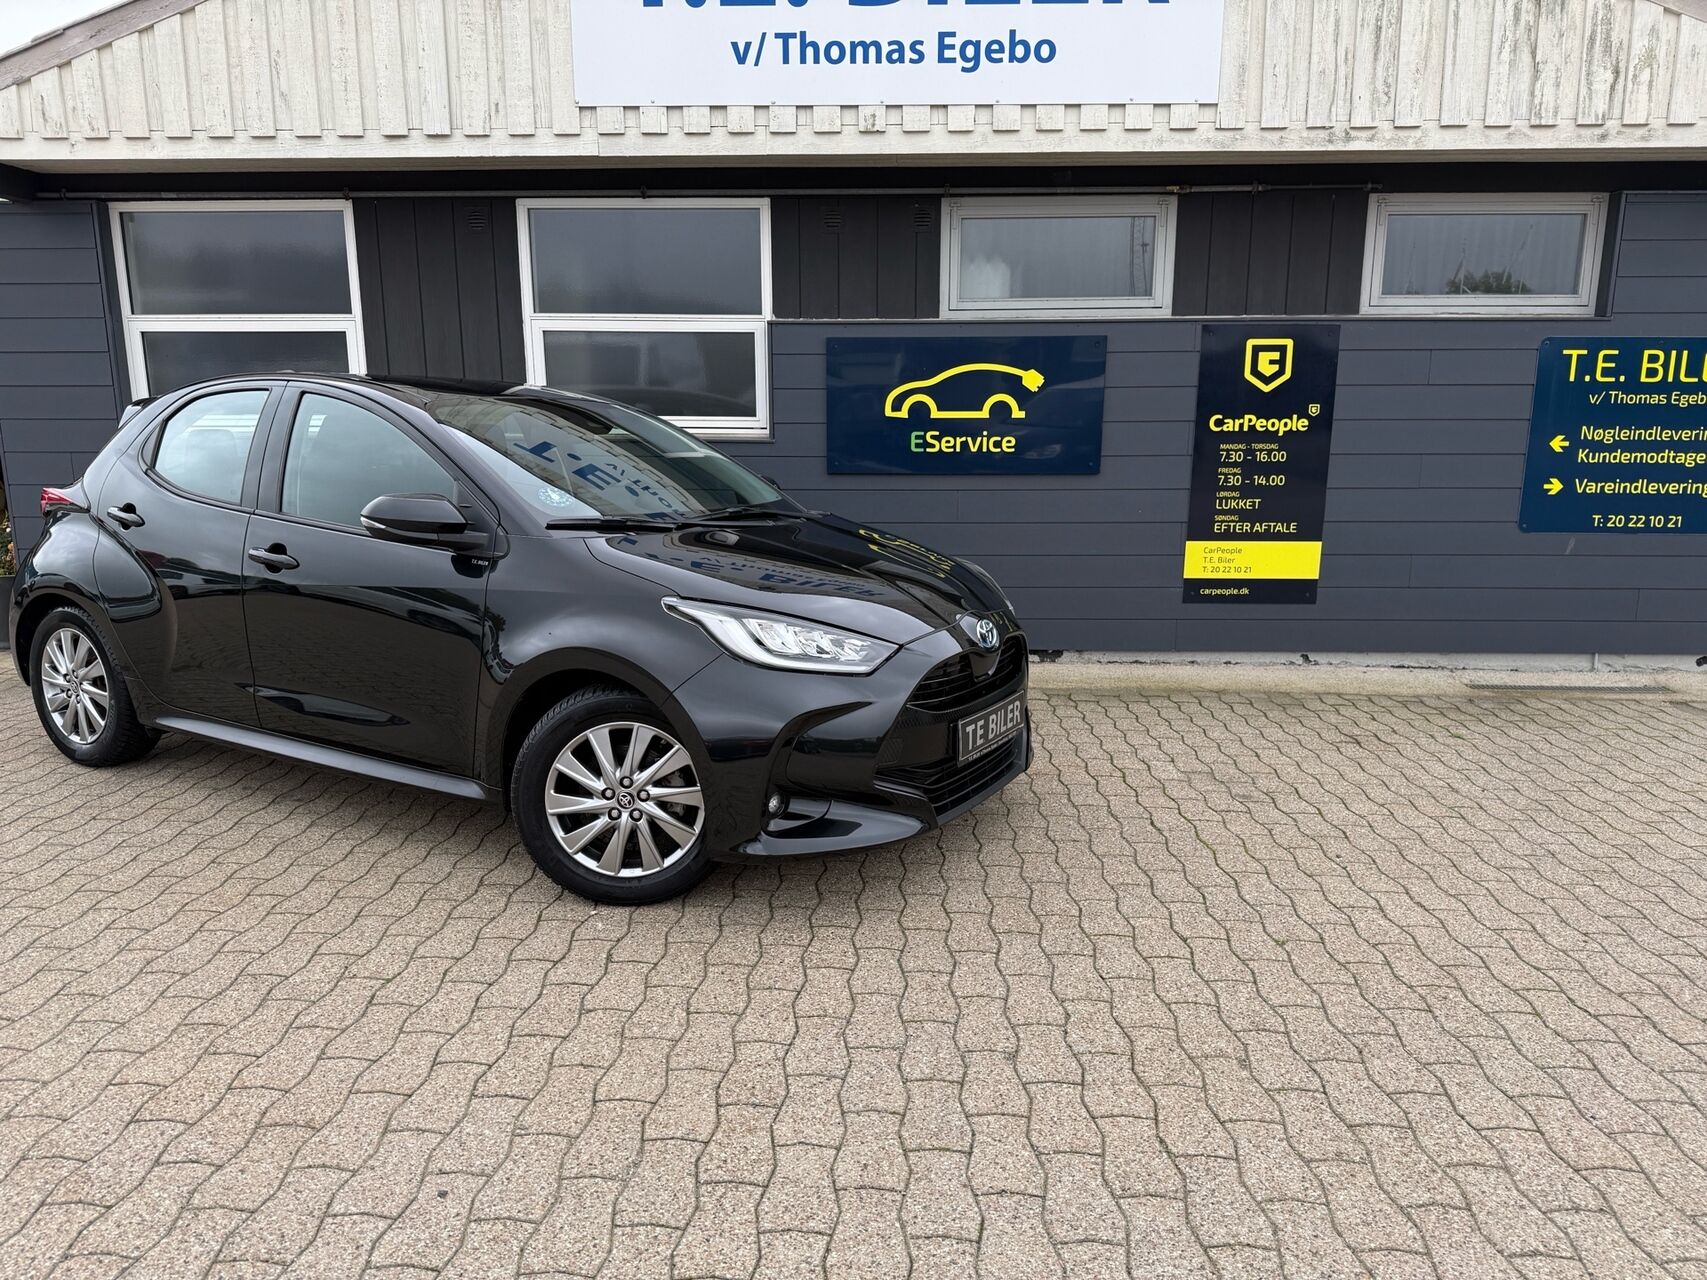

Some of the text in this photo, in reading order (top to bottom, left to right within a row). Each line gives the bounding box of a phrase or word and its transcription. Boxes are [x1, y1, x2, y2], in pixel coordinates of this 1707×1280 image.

[730, 29, 1056, 73] v/ Thomas Egebo
[1563, 350, 1707, 382] T.E. BIL
[1589, 391, 1605, 404] v/
[1609, 391, 1667, 404] Thomas
[1209, 414, 1309, 436] CarPeople
[911, 431, 1015, 452] EService
[1251, 442, 1279, 450] TORSDAG
[1220, 451, 1243, 462] 7.30
[1255, 451, 1286, 461] 16.00
[1218, 475, 1241, 485] 7.30
[1253, 475, 1285, 485] 14.00
[1215, 490, 1241, 498] LØRDAG
[1216, 499, 1261, 509] LUKKET
[1214, 514, 1240, 522] SØNDAG
[1592, 515, 1682, 527] T: 20 22 10 21
[1213, 522, 1298, 533] EFTER AFTALE
[1203, 546, 1243, 556] CarPeople
[1202, 556, 1236, 564] T.E. Biler
[1201, 565, 1252, 574] T: 20 22 10 21
[1199, 587, 1250, 597] carpeople.dk
[988, 701, 1021, 740] BILER
